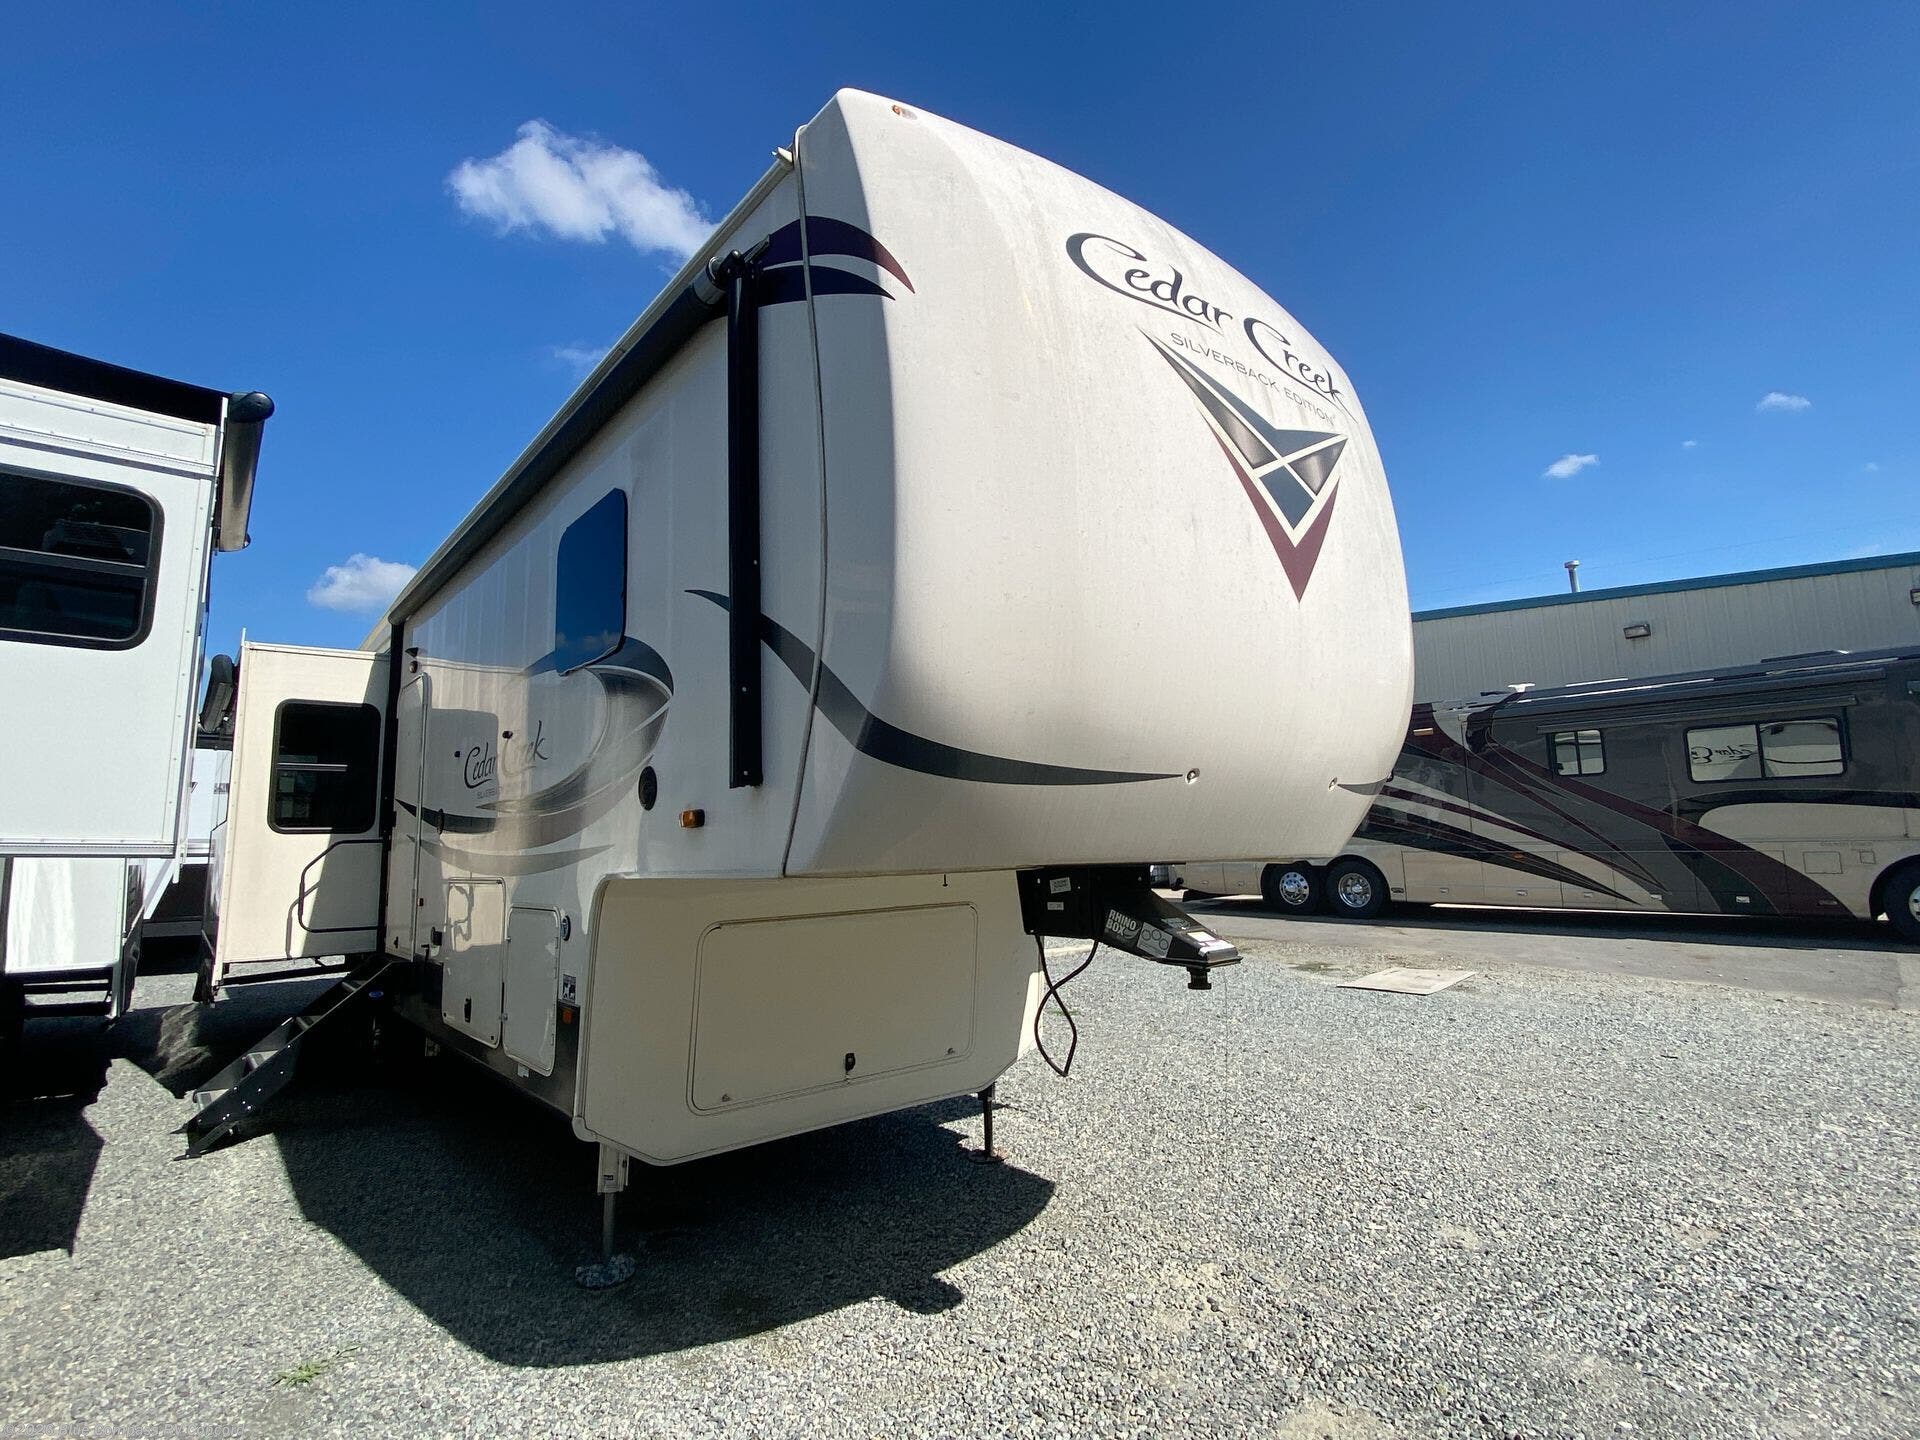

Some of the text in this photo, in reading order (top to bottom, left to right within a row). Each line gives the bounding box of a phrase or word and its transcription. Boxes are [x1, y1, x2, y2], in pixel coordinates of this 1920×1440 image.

[1066, 232, 1357, 423] Cedar Creek
[1171, 333, 1335, 427] SILVERBACK EDITION
[1106, 918, 1125, 936] BOX
[1109, 909, 1137, 930] RHINO
